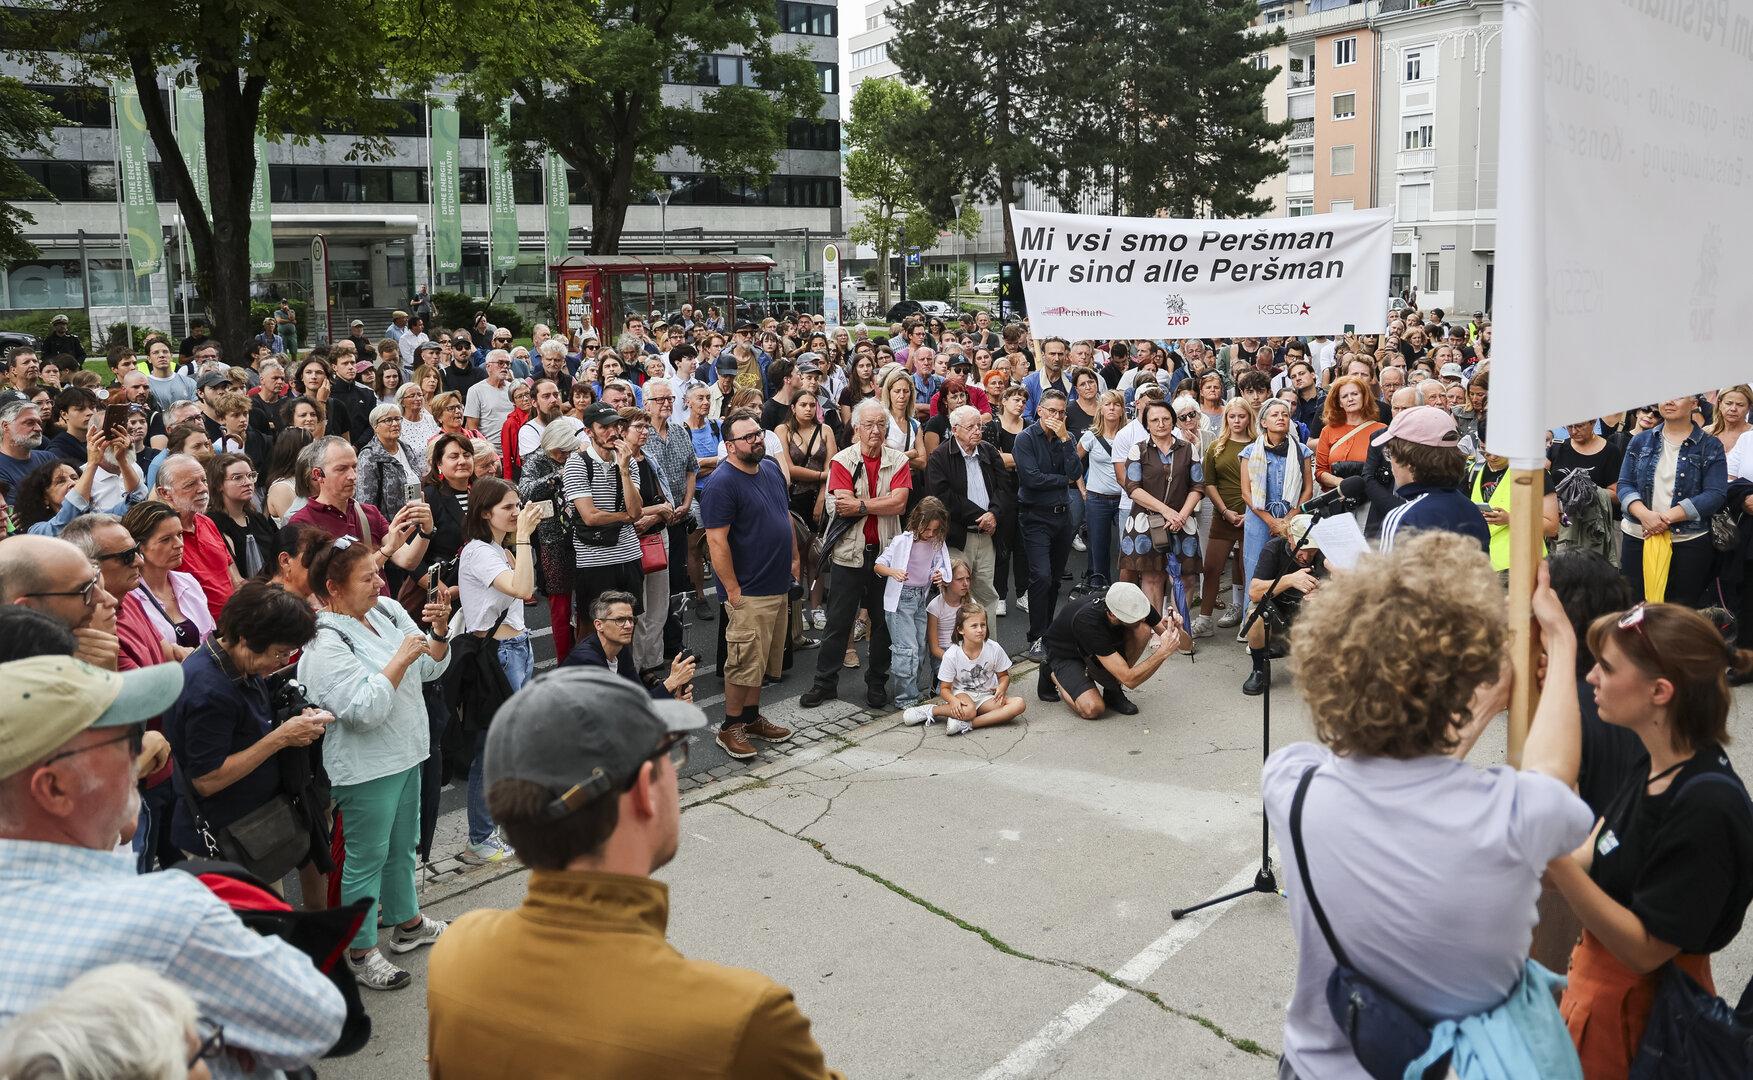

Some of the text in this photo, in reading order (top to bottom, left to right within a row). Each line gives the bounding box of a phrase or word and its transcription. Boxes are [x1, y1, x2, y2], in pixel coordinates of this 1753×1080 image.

[125, 145, 135, 180] ENERGIE
[134, 161, 143, 193] UNSERE
[493, 159, 501, 189] ENERGIE
[255, 168, 263, 200] UNSERE
[439, 161, 448, 214] DEINE ENERGIE
[447, 204, 455, 215] IST
[1020, 226, 1335, 252] Mi vsi smo Peršman
[1068, 259, 1135, 283] sind
[1143, 259, 1199, 283] alle
[1209, 256, 1345, 283] Peršman
[1167, 316, 1190, 326] ZKP
